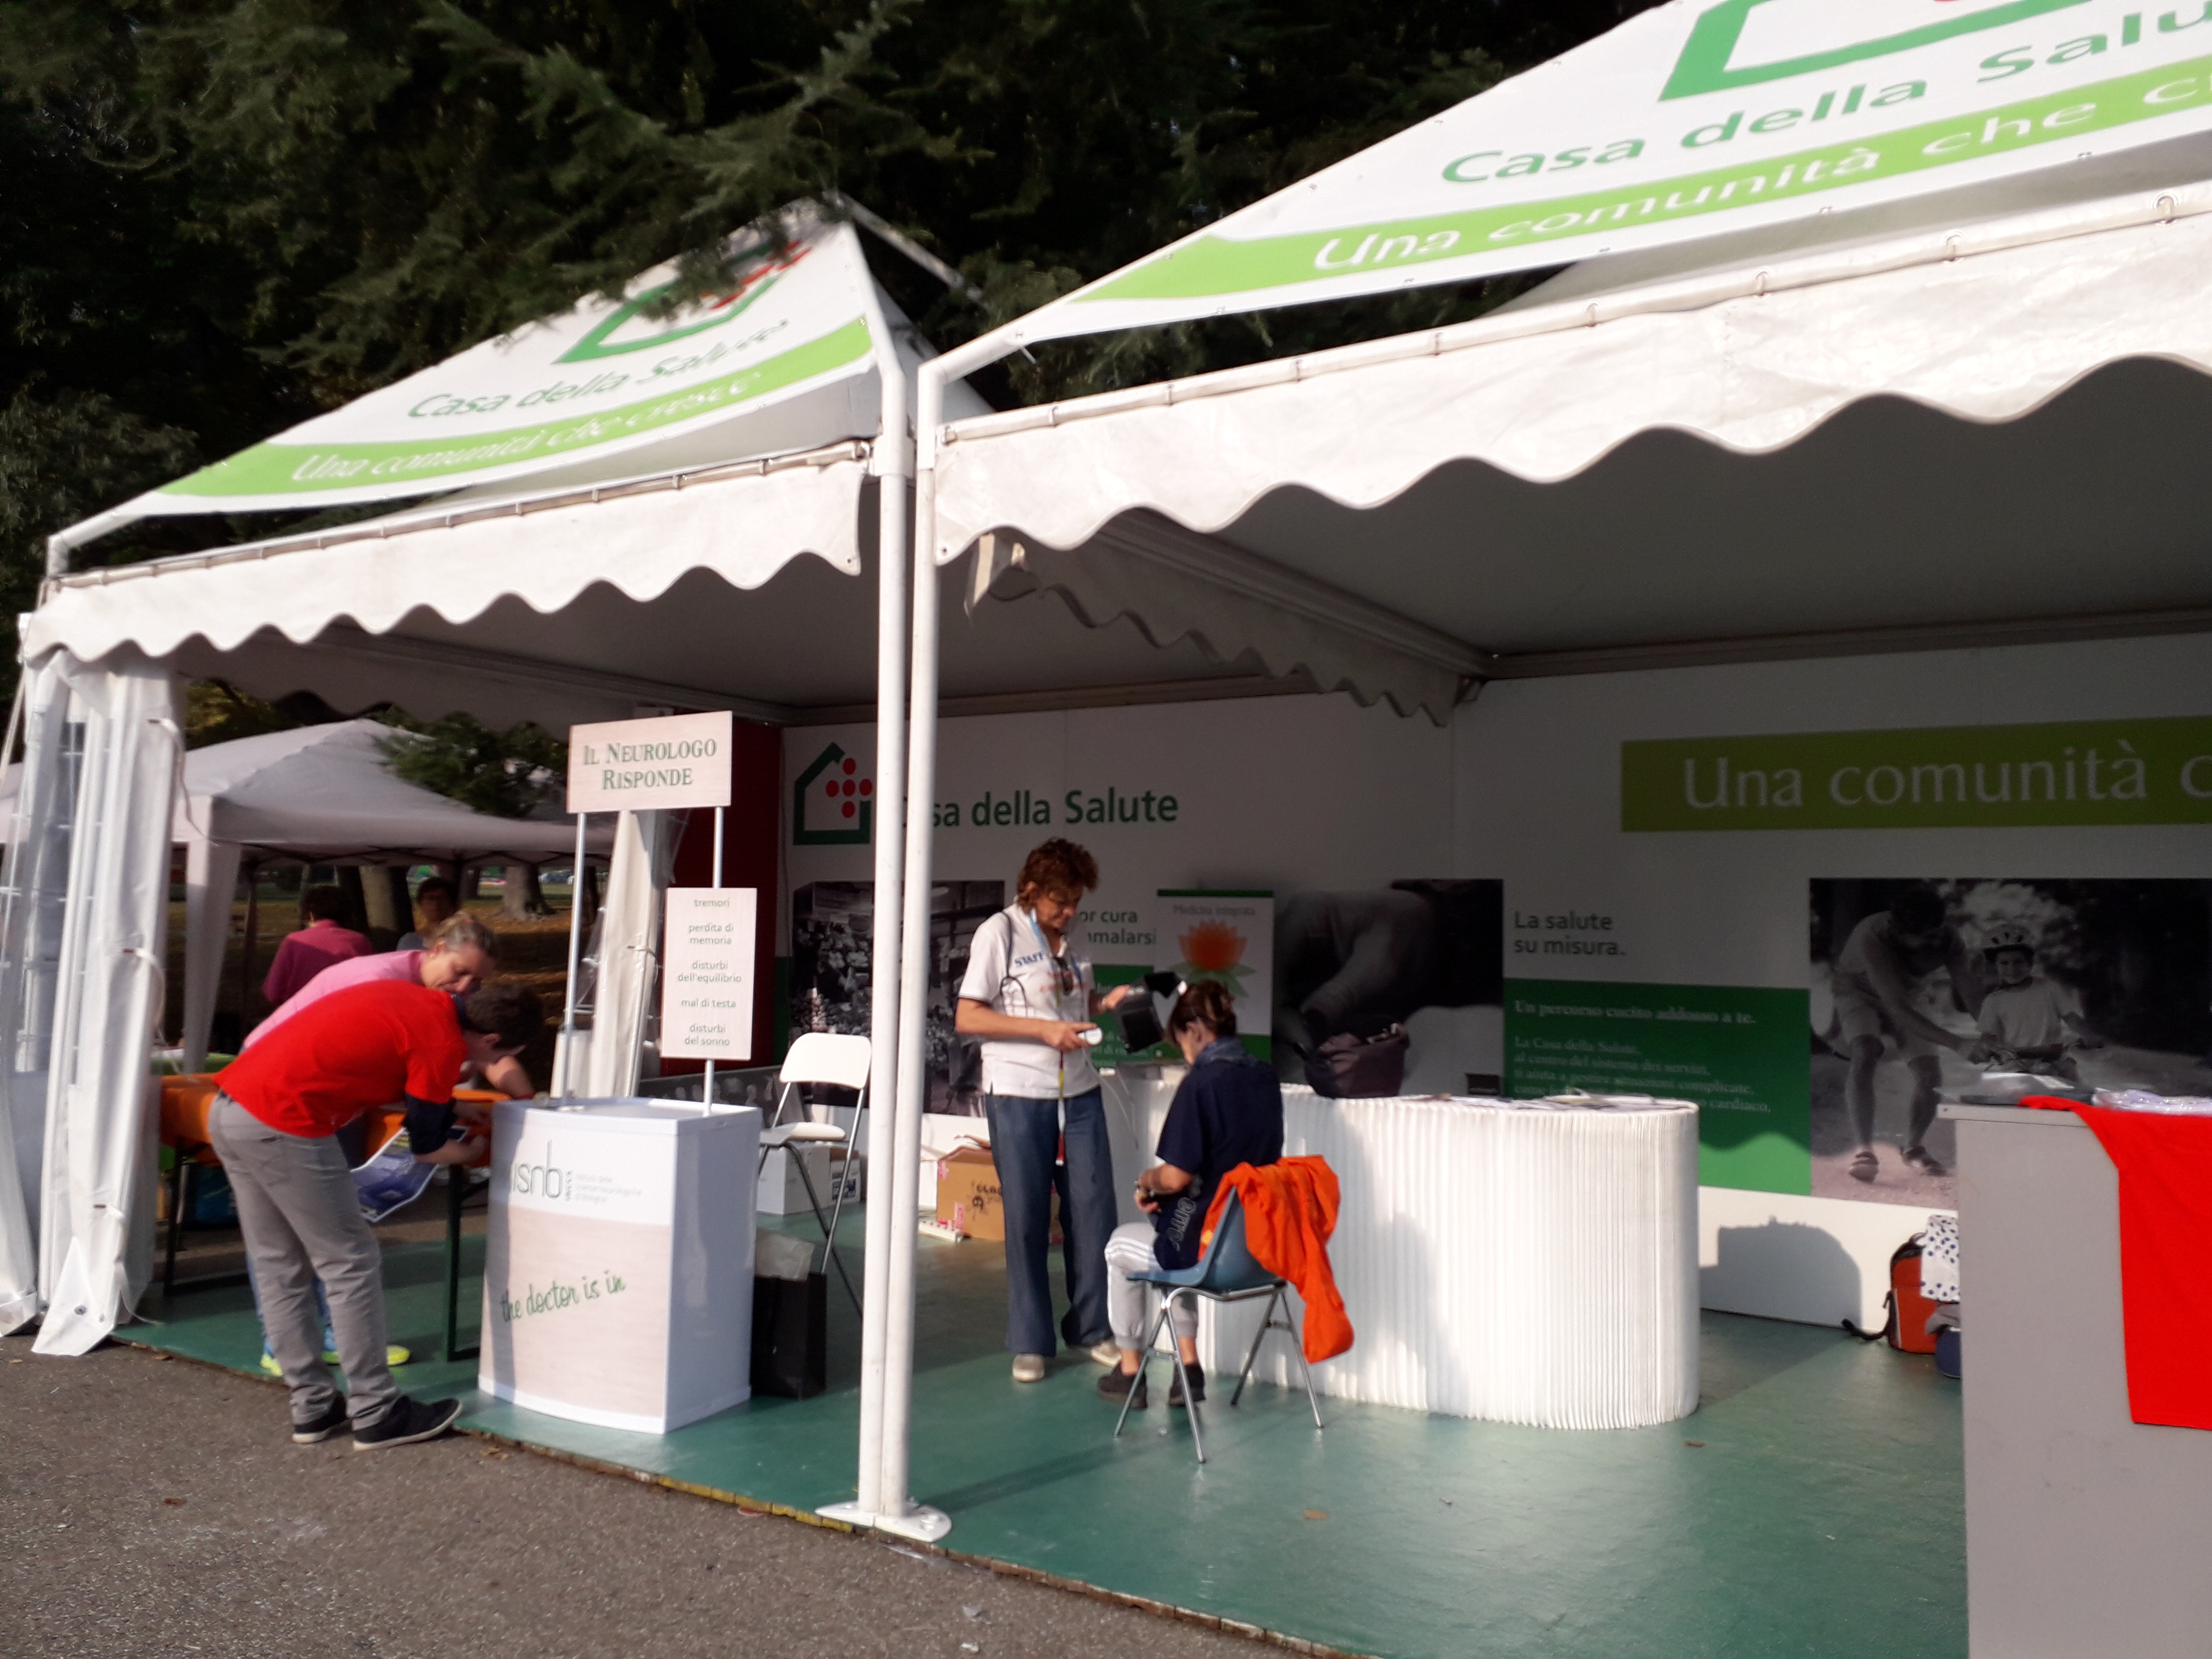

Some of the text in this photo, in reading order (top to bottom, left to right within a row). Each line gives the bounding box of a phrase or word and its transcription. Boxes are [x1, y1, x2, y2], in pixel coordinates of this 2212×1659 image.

[1443, 138, 1646, 183] Casa
[1681, 79, 1927, 149] della
[1314, 103, 2096, 268] Una comunità che
[408, 392, 512, 418] Casa
[515, 370, 631, 407] della
[292, 453, 370, 481] Una
[1684, 756, 1802, 809] Una
[1829, 738, 2146, 805] comunità
[971, 790, 1051, 826] della
[1065, 786, 1179, 825] Salute
[693, 898, 730, 907] tremori
[1101, 910, 1138, 923] cura
[1514, 911, 1613, 930] La salute
[689, 922, 734, 933] perdita di
[690, 935, 732, 945] memoria
[1088, 928, 1157, 945] malarsi
[1514, 935, 1626, 955] su misura.
[692, 960, 728, 969] disturbi
[678, 972, 742, 984] dell'equilibrio
[682, 998, 737, 1008] mal di testa
[690, 1023, 726, 1033] disturbi
[685, 1036, 699, 1045] del
[500, 1269, 626, 1322] the doctor is in
